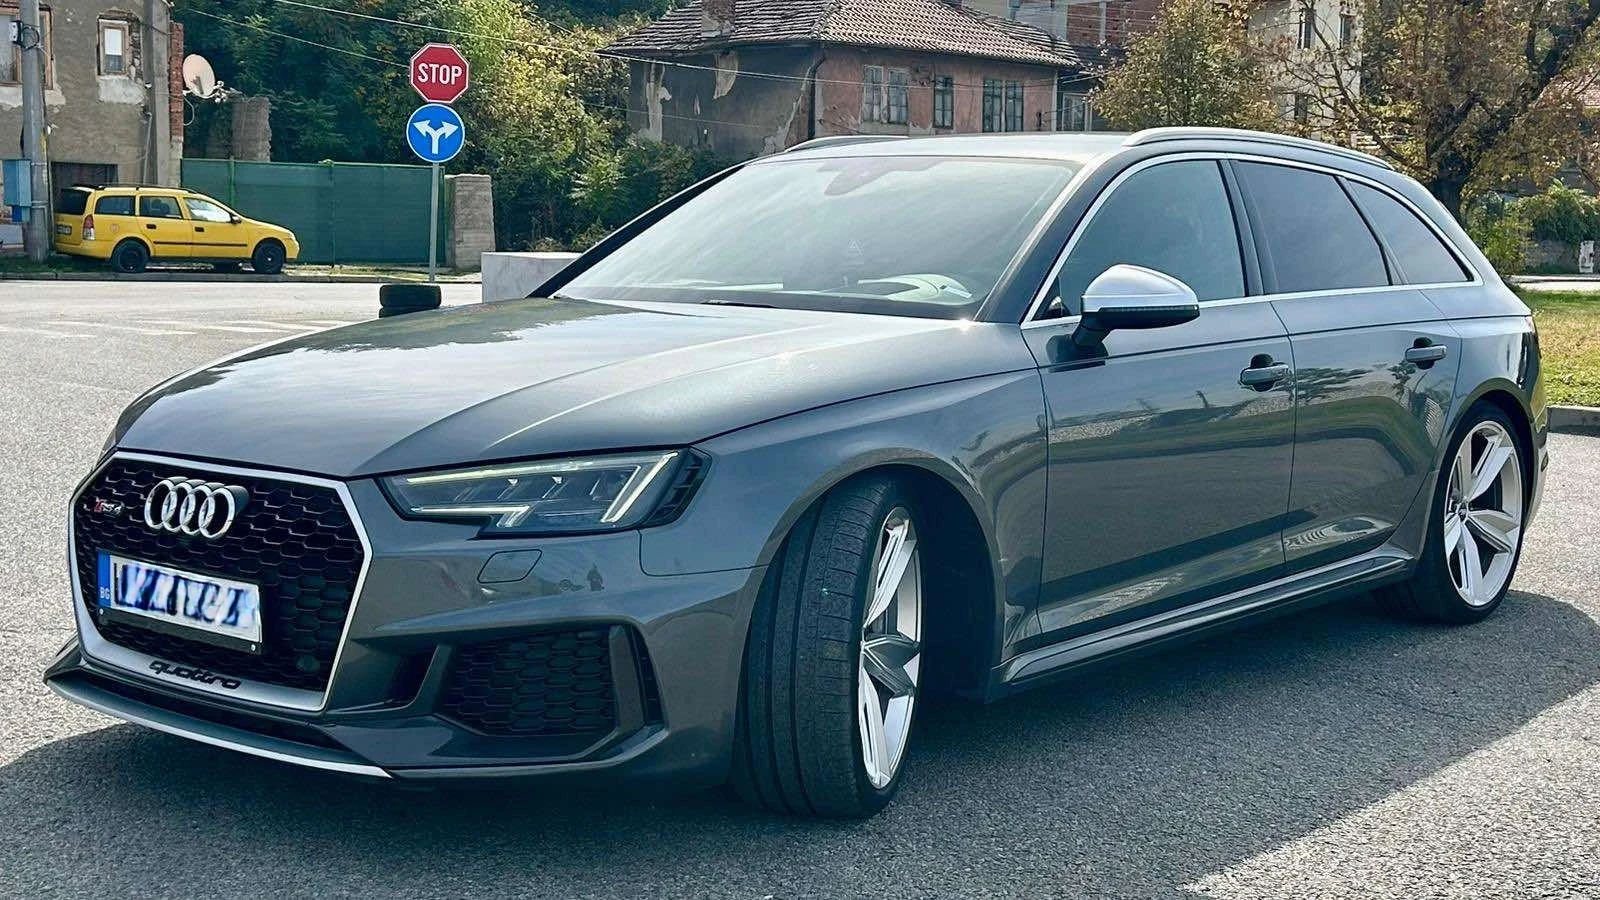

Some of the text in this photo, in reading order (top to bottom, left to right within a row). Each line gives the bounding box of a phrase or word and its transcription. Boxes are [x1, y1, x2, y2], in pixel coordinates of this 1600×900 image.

[418, 63, 462, 85] STOP
[100, 586, 110, 599] BG
[149, 660, 241, 690] quattro
